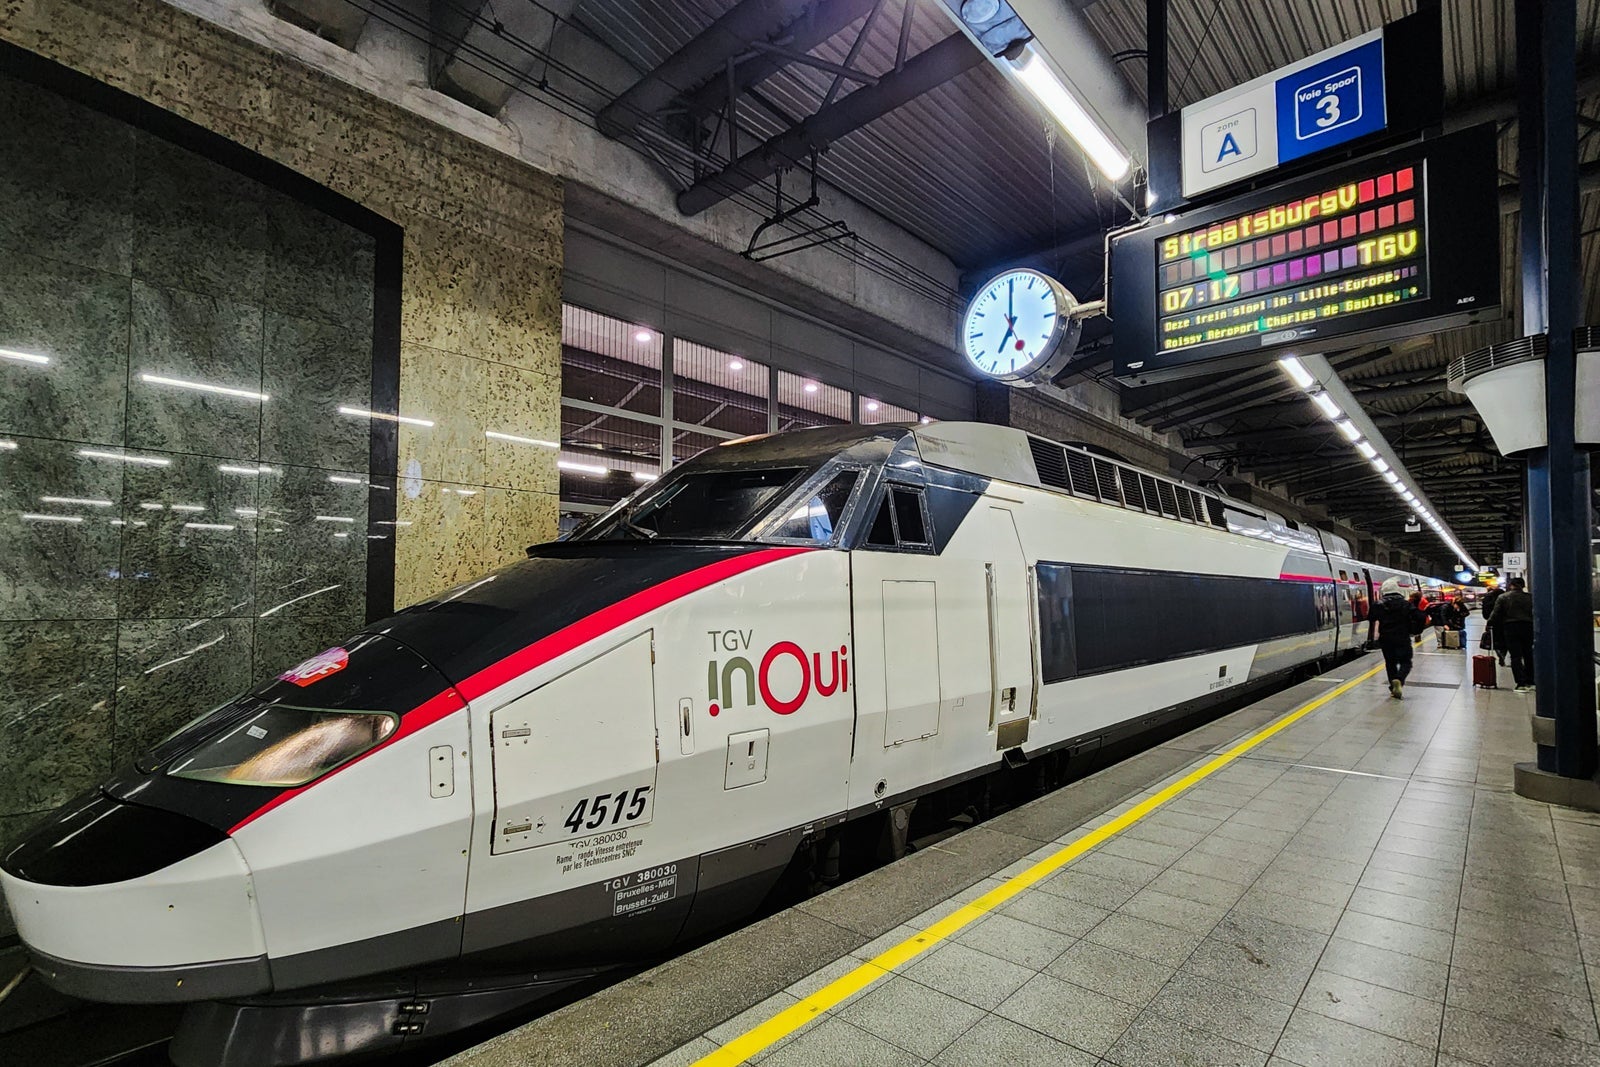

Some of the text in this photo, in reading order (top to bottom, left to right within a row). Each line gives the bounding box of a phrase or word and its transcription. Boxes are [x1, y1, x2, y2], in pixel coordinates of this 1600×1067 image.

[1299, 75, 1357, 103] Voie Spoor
[1316, 95, 1341, 127] 3
[1217, 119, 1239, 132] zone
[1216, 132, 1242, 163] A
[1358, 231, 1418, 264] TGV
[1164, 276, 1239, 312] 07:17
[1456, 296, 1475, 305] AEG
[1164, 318, 1190, 332] Deze
[1195, 310, 1227, 325] trein
[1232, 300, 1266, 316] stopt
[1164, 334, 1202, 349] Roissy
[1266, 308, 1317, 328] Charles
[1323, 302, 1339, 317] de
[708, 629, 753, 652] TGV
[564, 785, 651, 834] 4515
[556, 854, 573, 865] Rame
[595, 845, 615, 858] Vitesse
[615, 838, 644, 852] entretenue
[593, 830, 627, 847] 380030
[562, 848, 637, 875] par les Technicentres SNCF
[603, 864, 677, 892] TGV 380030
[617, 876, 675, 902] Bruxelles-Midi
[616, 890, 669, 914] Brussel-Zuid
